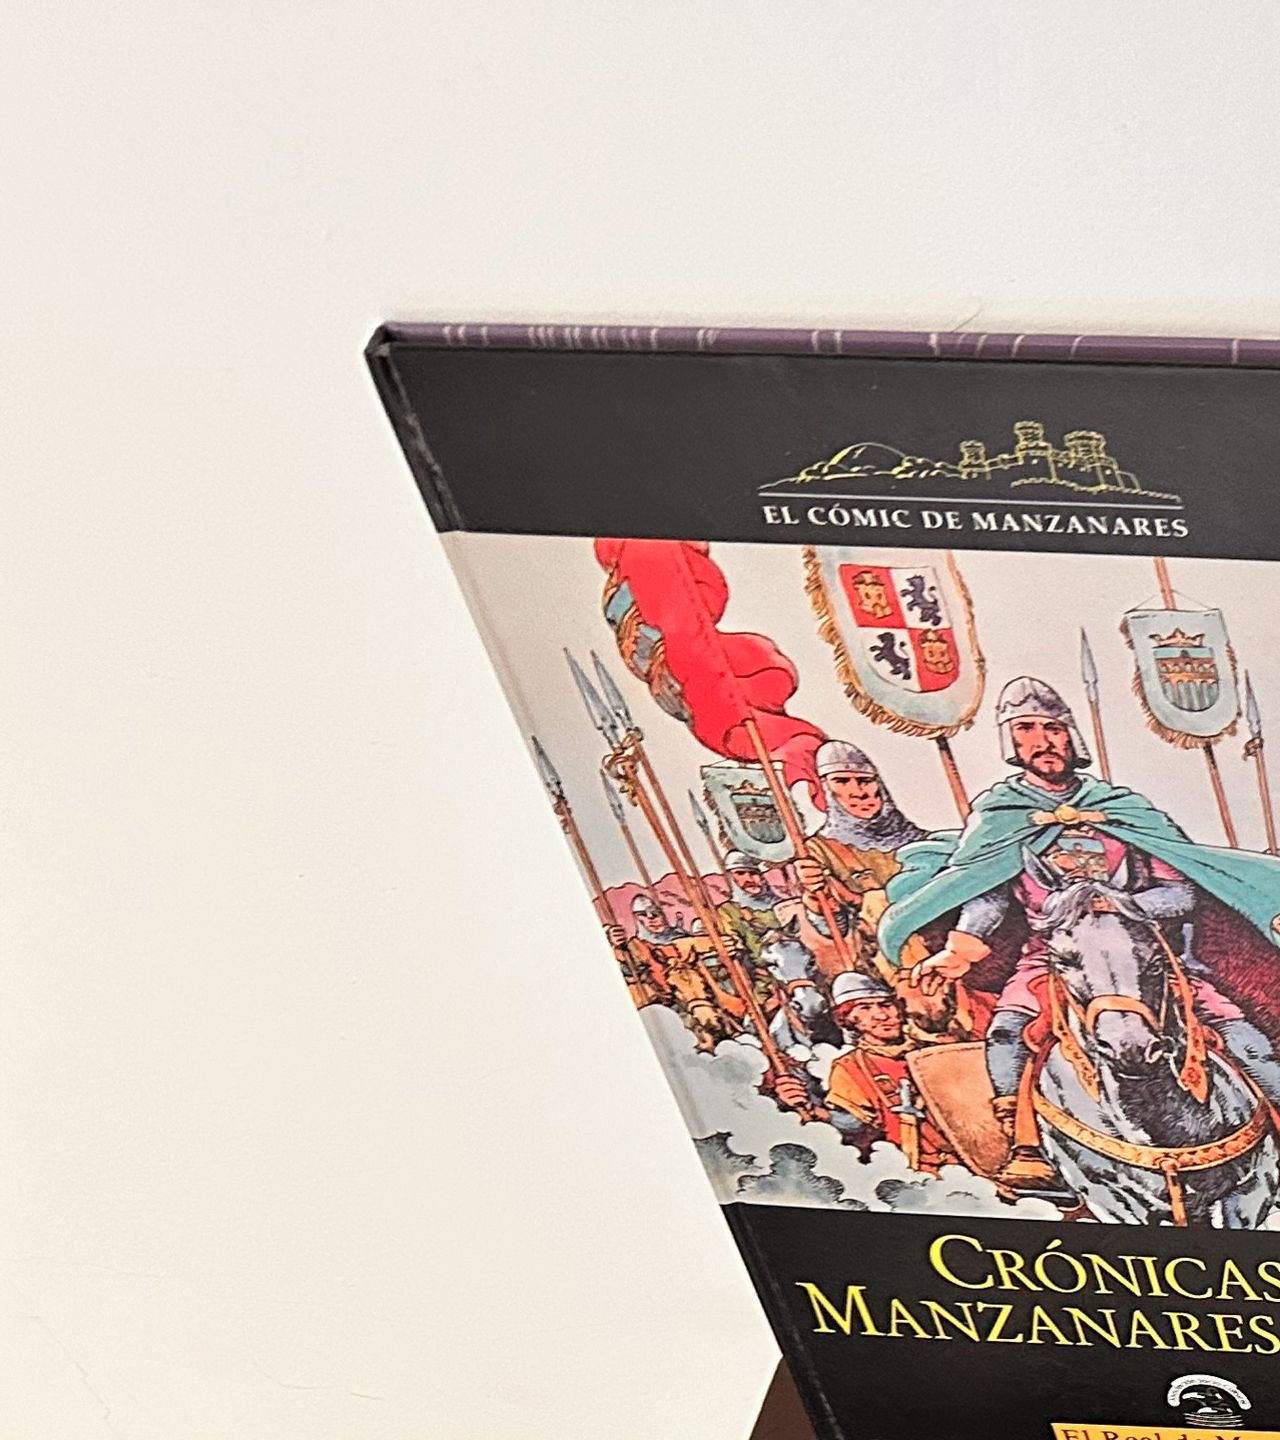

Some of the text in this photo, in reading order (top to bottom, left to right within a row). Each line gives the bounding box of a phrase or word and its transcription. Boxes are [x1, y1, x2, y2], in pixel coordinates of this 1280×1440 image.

[763, 503, 1189, 538] EL CÓMIC DE MANZANARES
